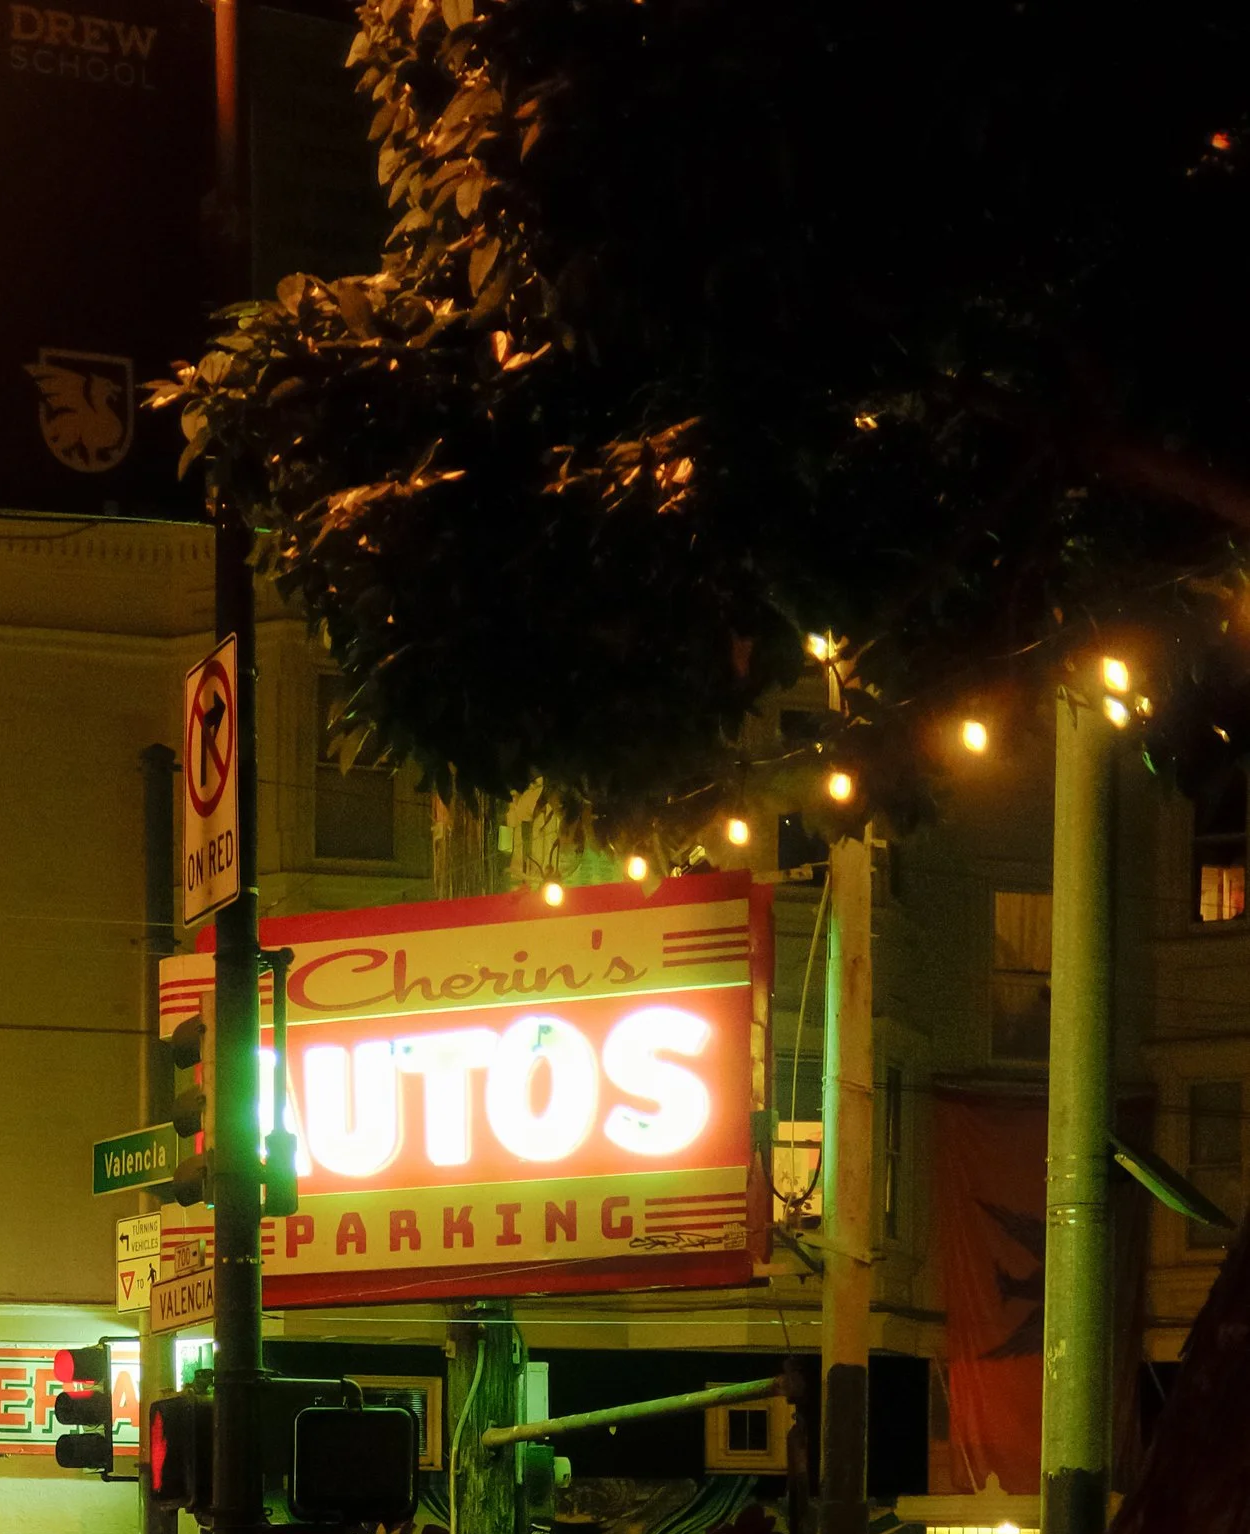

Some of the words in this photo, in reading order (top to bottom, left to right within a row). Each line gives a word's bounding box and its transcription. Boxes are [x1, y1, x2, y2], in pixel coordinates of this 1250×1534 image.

[10, 4, 158, 61] DREW
[10, 44, 157, 90] SCHOOL
[188, 848, 204, 891] ON
[209, 829, 233, 879] RED
[287, 929, 648, 1011] Cherin's
[104, 1140, 166, 1179] Valencia
[131, 1237, 159, 1253] VEHICLES
[132, 1220, 158, 1236] TURNING
[285, 1196, 634, 1258] PARKING
[177, 1247, 191, 1269] 700
[137, 1279, 145, 1290] TO
[160, 1278, 214, 1321] VALENCIA
